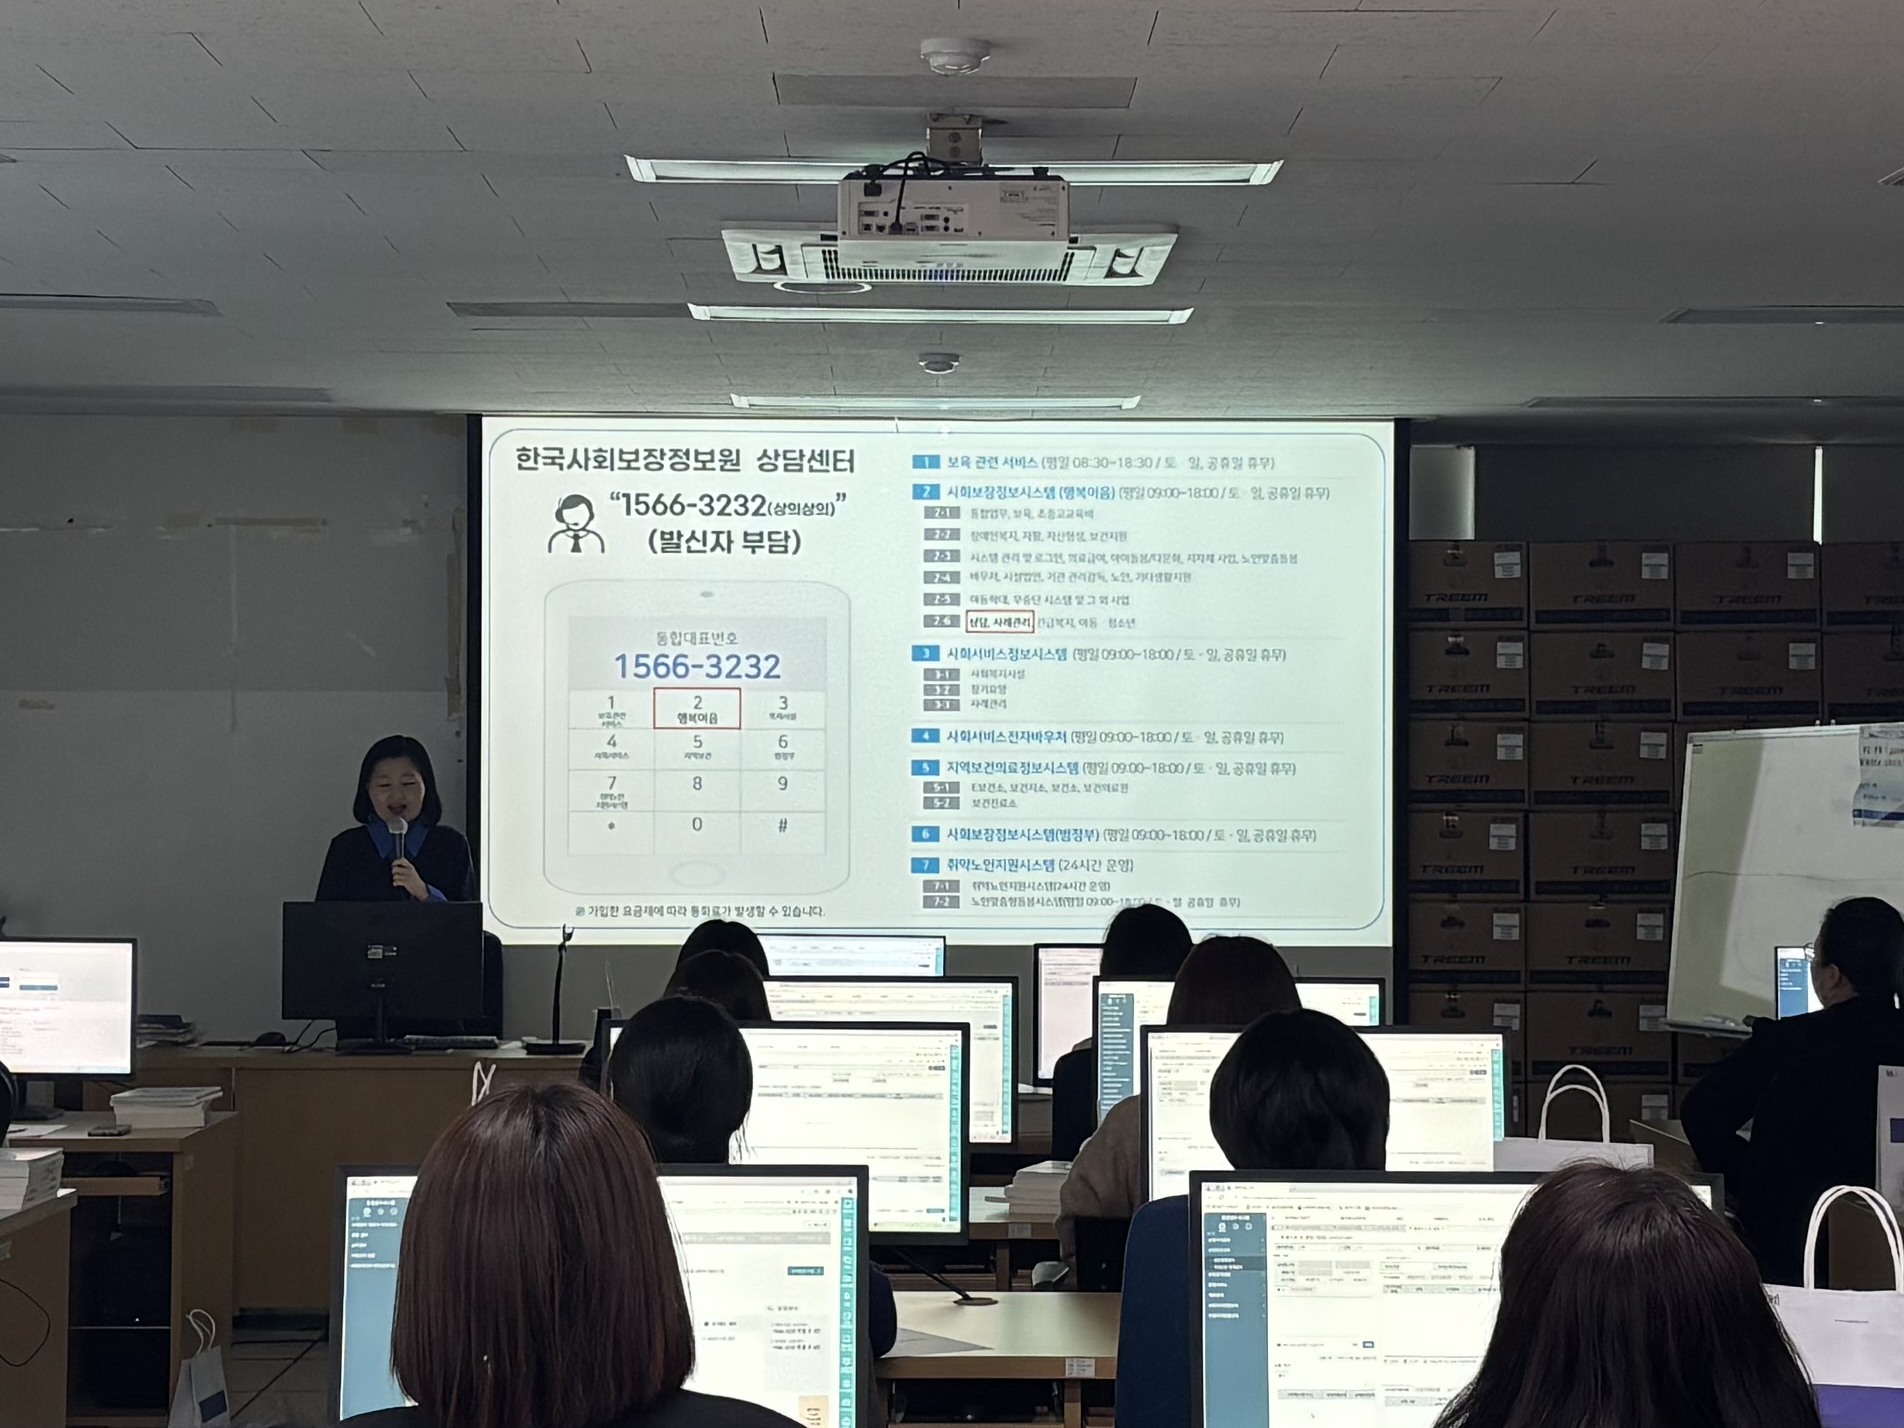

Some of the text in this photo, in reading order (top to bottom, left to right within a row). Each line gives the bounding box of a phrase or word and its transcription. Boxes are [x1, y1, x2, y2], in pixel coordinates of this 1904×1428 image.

[516, 447, 855, 473] 한국사회보장정보원 상담센터
[948, 457, 971, 469] 보육
[976, 456, 998, 469] 관련
[1003, 457, 1037, 469] 서비스
[1073, 457, 1152, 469] 08:30~18:30
[948, 486, 1056, 500] 사회보장정보시스템
[1060, 486, 1114, 500] (행복이음)
[1147, 488, 1218, 499] 09:00~18:00
[649, 529, 801, 554] (발신자 부담)
[1424, 593, 1488, 601] TREEM
[1572, 595, 1635, 603] TREEM
[656, 632, 738, 646] 통합대표번호
[948, 648, 1067, 661] 사회서비스정보시스템
[1102, 649, 1173, 660] 09:00~18:00
[615, 654, 781, 679] 1566-3232
[1426, 684, 1490, 693] TREEM
[1572, 685, 1636, 694] TREEM
[608, 696, 614, 709] 1
[693, 697, 702, 709] 2
[779, 697, 788, 710] 3
[607, 736, 616, 747] 4
[693, 735, 702, 748] 5
[778, 735, 787, 749] 6
[1100, 732, 1171, 743] 09:00~18:00
[948, 762, 1078, 774] 지역보건의료정보시스템
[1112, 762, 1183, 774] 09:00~18:00
[608, 776, 616, 790] 7
[693, 777, 702, 790] 8
[778, 777, 787, 790] 9
[1426, 775, 1489, 784] TREEM
[1571, 775, 1634, 785] TREEM
[692, 817, 702, 831] 0
[1132, 829, 1204, 841] 09:00~18:00
[948, 859, 1055, 872] 취약노인지원시스템
[1059, 859, 1102, 872] (24시간
[1107, 859, 1134, 872] 운영)
[1420, 865, 1484, 874] TREEM
[1572, 866, 1635, 875] TREEM
[588, 906, 619, 917] 가입한
[623, 906, 664, 917] 요금제에
[666, 906, 687, 917] 따라
[735, 906, 765, 917] 발생할
[769, 907, 778, 917] 수
[782, 906, 826, 917] 있습니다.
[1422, 955, 1485, 964] TREEM
[1566, 956, 1631, 965] TREEM
